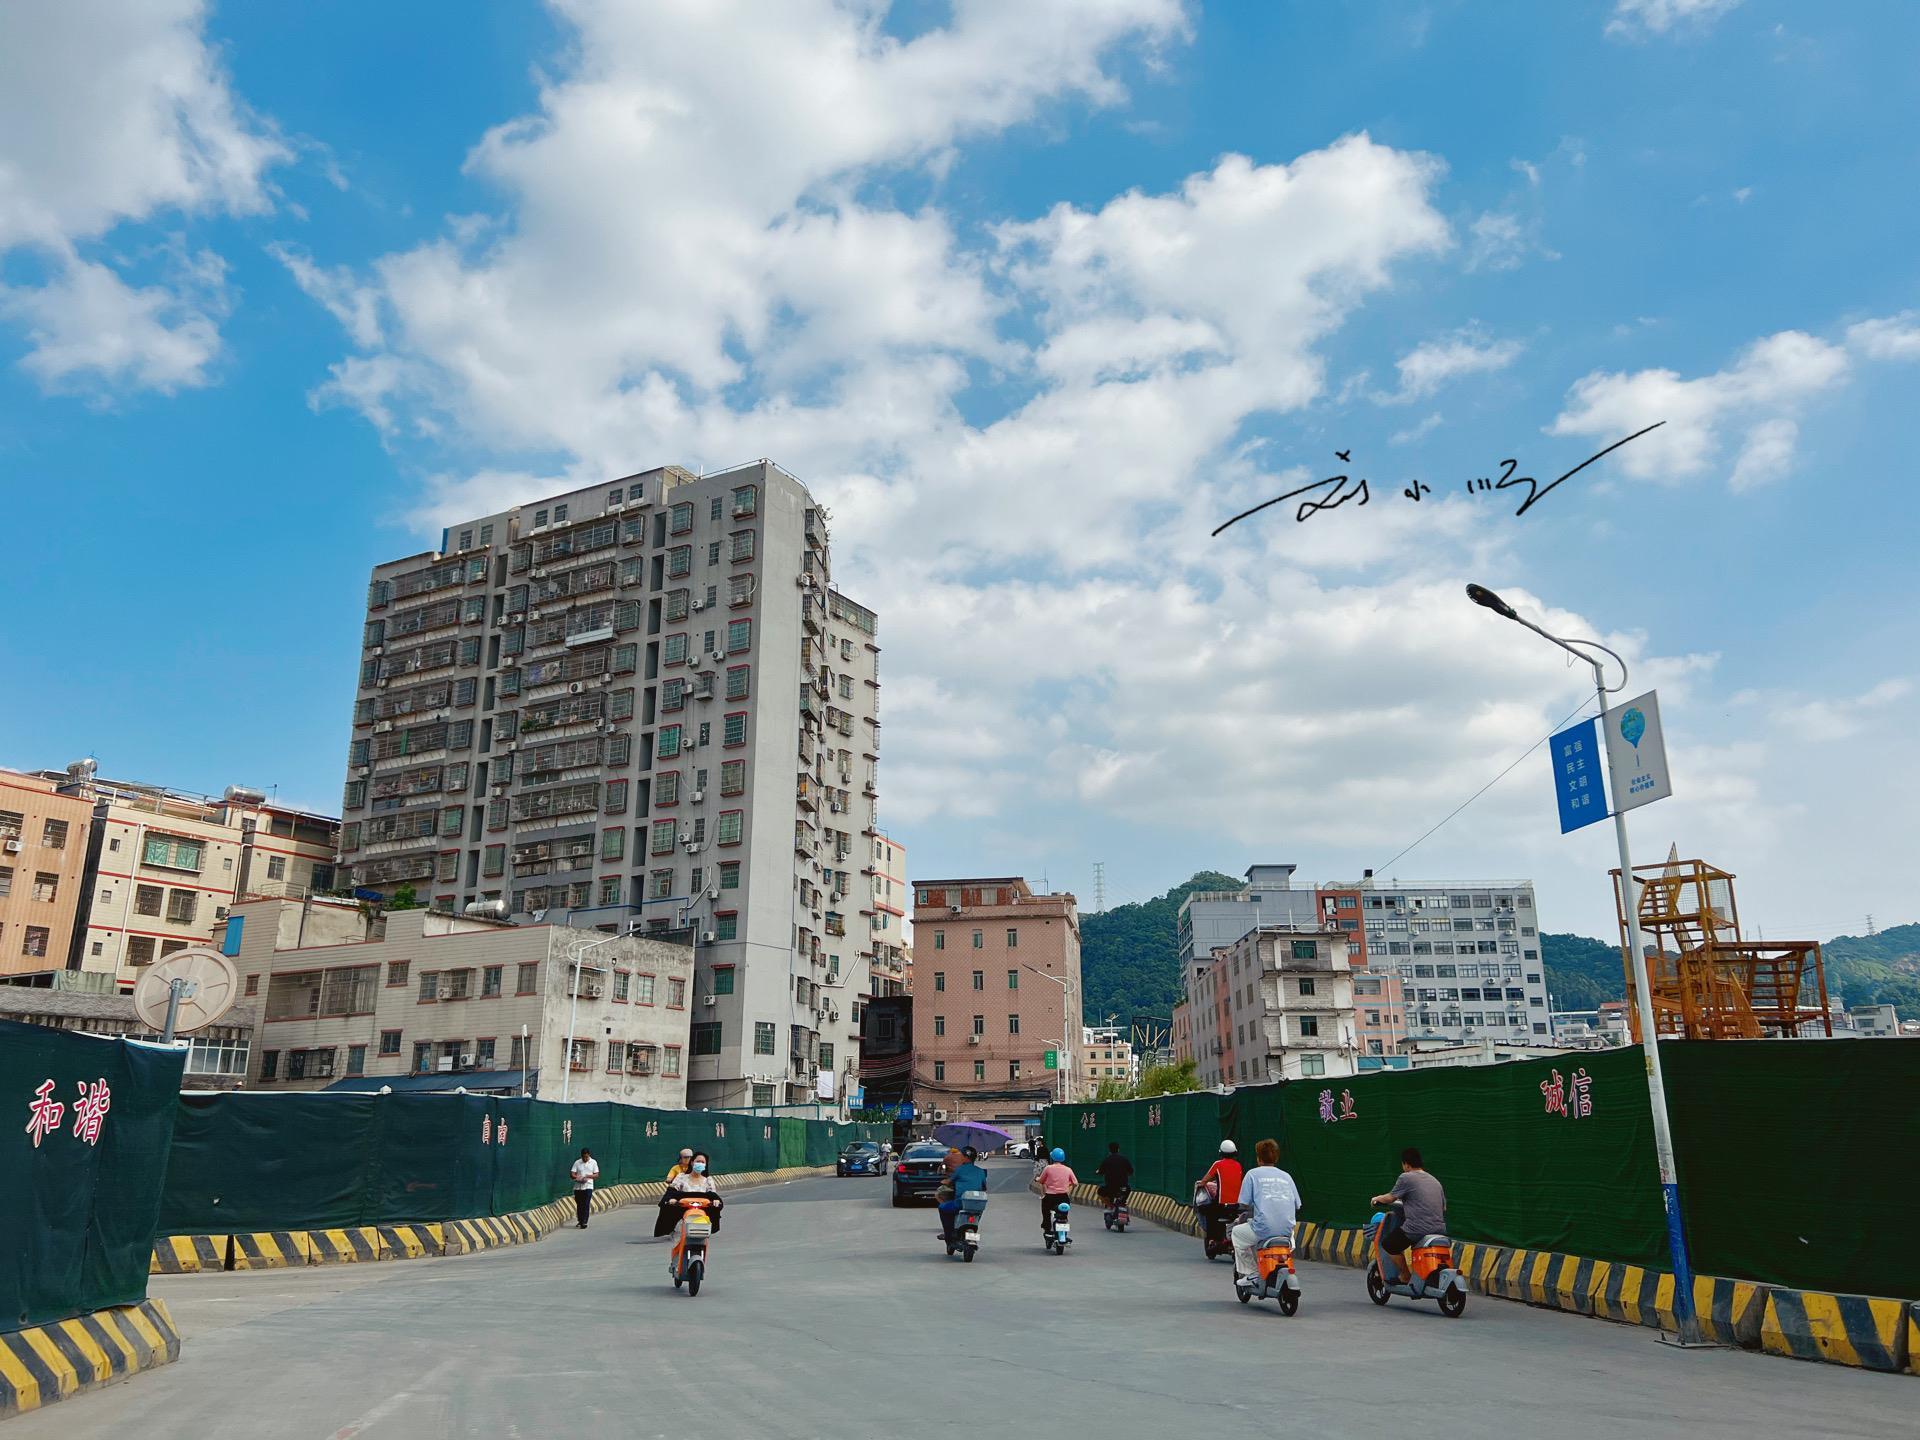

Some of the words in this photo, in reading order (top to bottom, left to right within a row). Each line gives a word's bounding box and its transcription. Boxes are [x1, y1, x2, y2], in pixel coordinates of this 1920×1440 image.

[1567, 759, 1585, 774] 民主
[1569, 775, 1588, 792] 文明
[1319, 1088, 1358, 1123] 敬业
[1540, 1068, 1592, 1119] 诚信
[25, 1077, 110, 1148] 和谐
